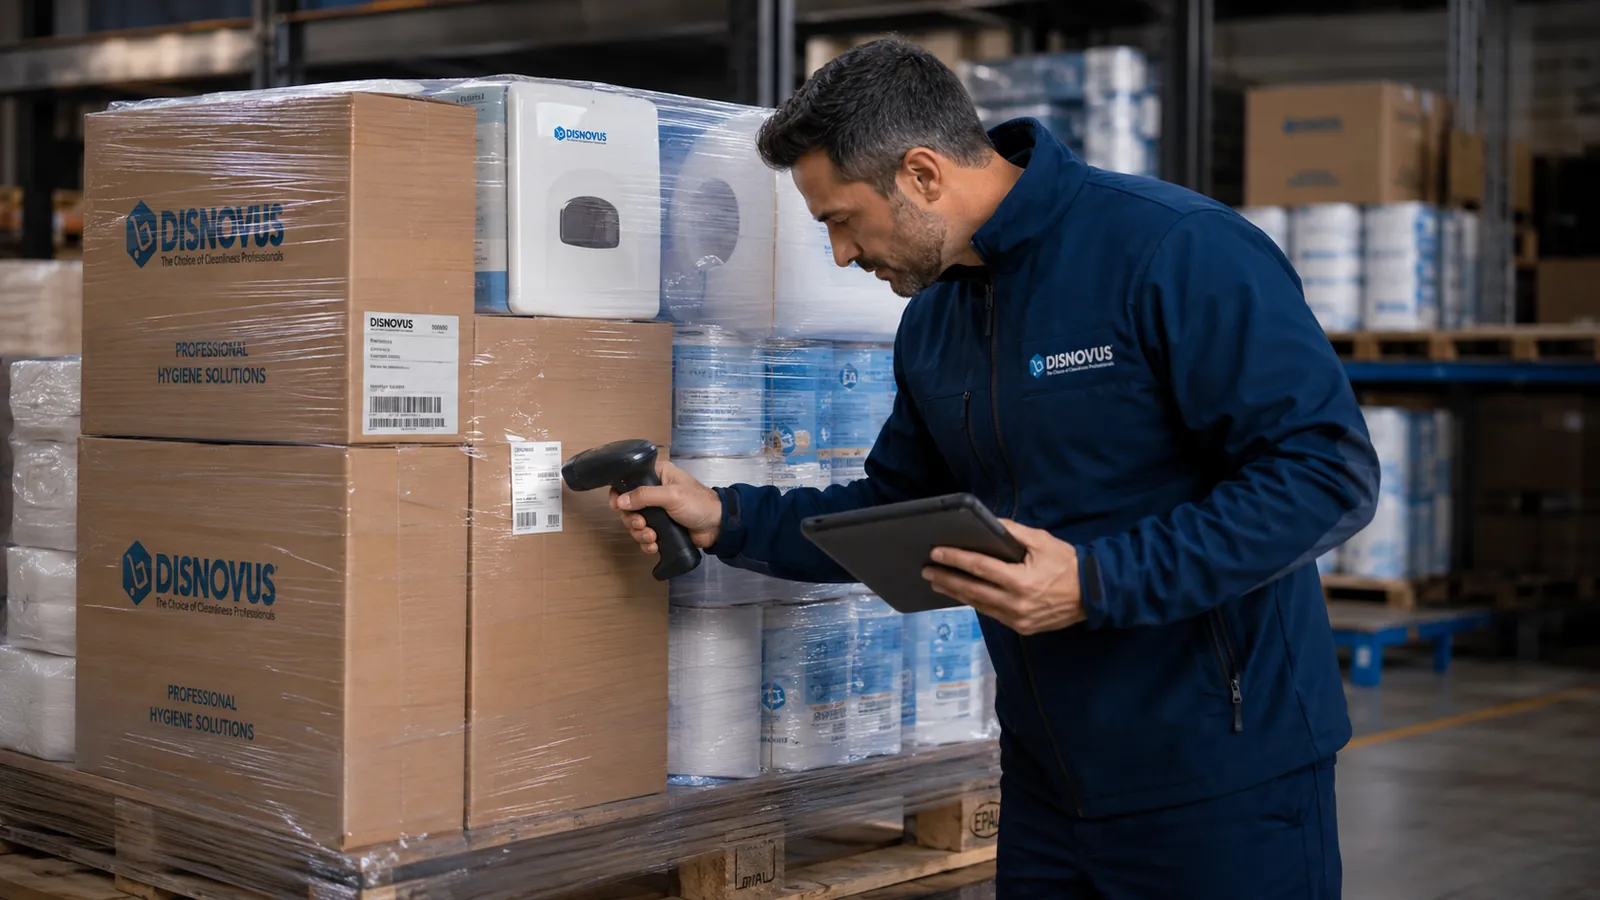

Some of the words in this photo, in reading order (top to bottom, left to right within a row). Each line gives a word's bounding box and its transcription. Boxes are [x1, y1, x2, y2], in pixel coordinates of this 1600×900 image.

[566, 129, 607, 141] DISNOVUS
[161, 203, 284, 252] DISNOVUS
[161, 256, 173, 267] The
[174, 255, 196, 266] Choice
[197, 253, 204, 265] of
[204, 253, 241, 265] Cleanliness
[241, 251, 284, 263] Professionals
[370, 317, 413, 329] DISNOVUS
[175, 341, 249, 358] PROFESSIONAL
[1046, 345, 1113, 370] DISNOVUS
[157, 366, 203, 384] HYGIENE
[205, 366, 266, 384] SOLUTIONS
[156, 553, 276, 606] DISNOVUS
[156, 597, 167, 608] The
[168, 599, 189, 611] Choice
[190, 600, 197, 612] of
[197, 602, 233, 616] Cleanliness
[234, 607, 276, 621] Professionals
[167, 684, 237, 711] PROFESSIONAL
[150, 706, 193, 729] HYGIENE
[195, 714, 254, 740] SOLUTIONS
